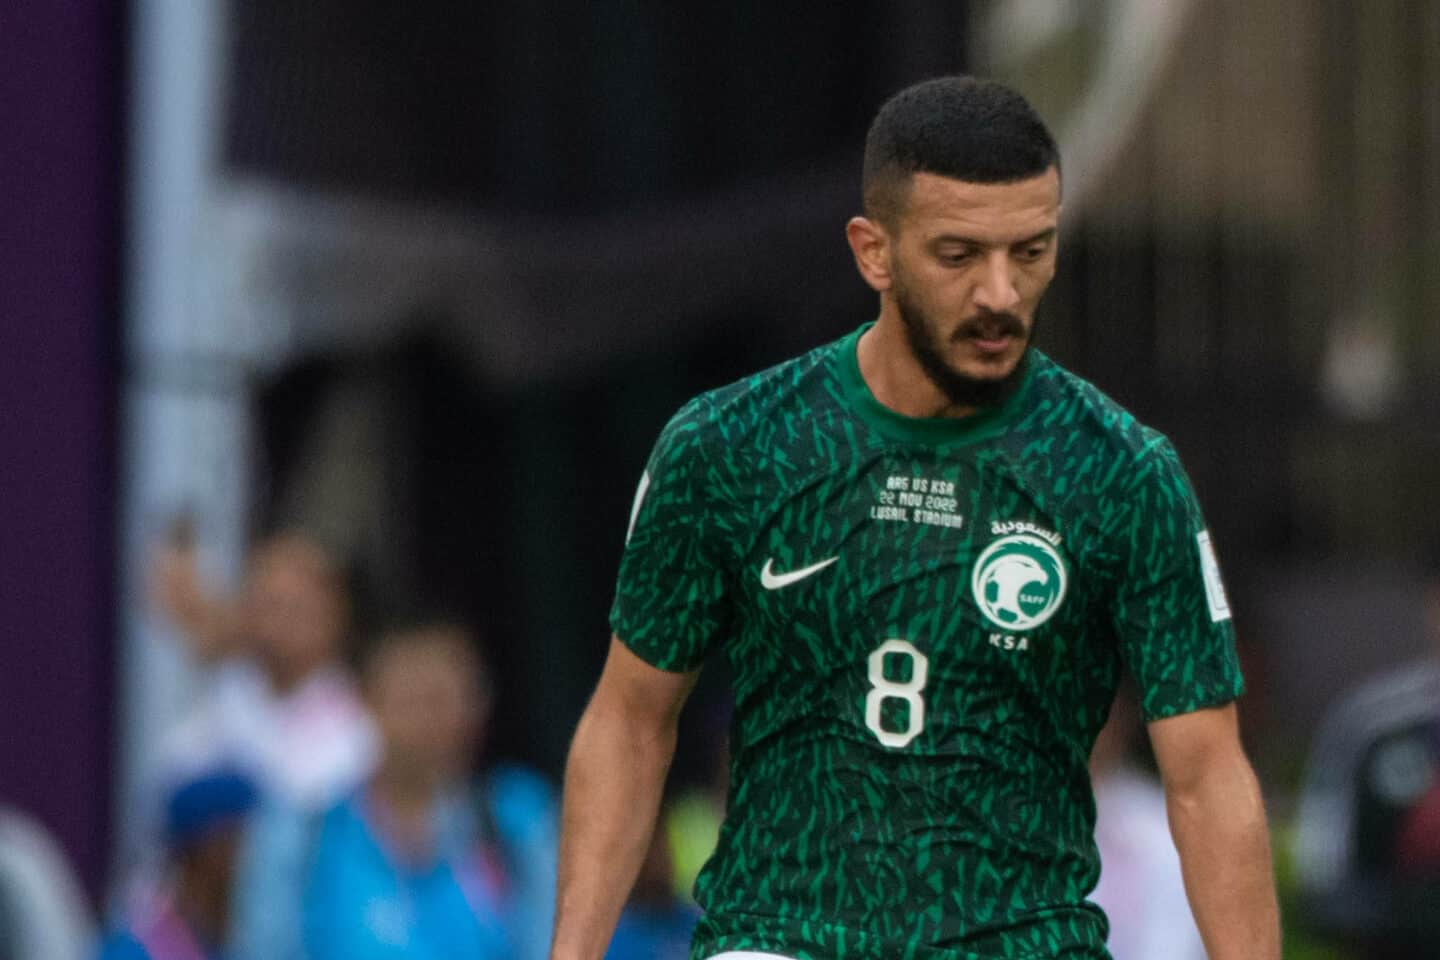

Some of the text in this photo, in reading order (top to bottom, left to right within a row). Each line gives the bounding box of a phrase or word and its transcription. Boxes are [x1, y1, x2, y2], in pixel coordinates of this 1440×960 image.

[930, 480, 955, 496] KSA
[879, 490, 896, 505] 22
[925, 495, 958, 513] 2022
[988, 633, 1029, 651] KSA
[865, 638, 929, 748] 8
